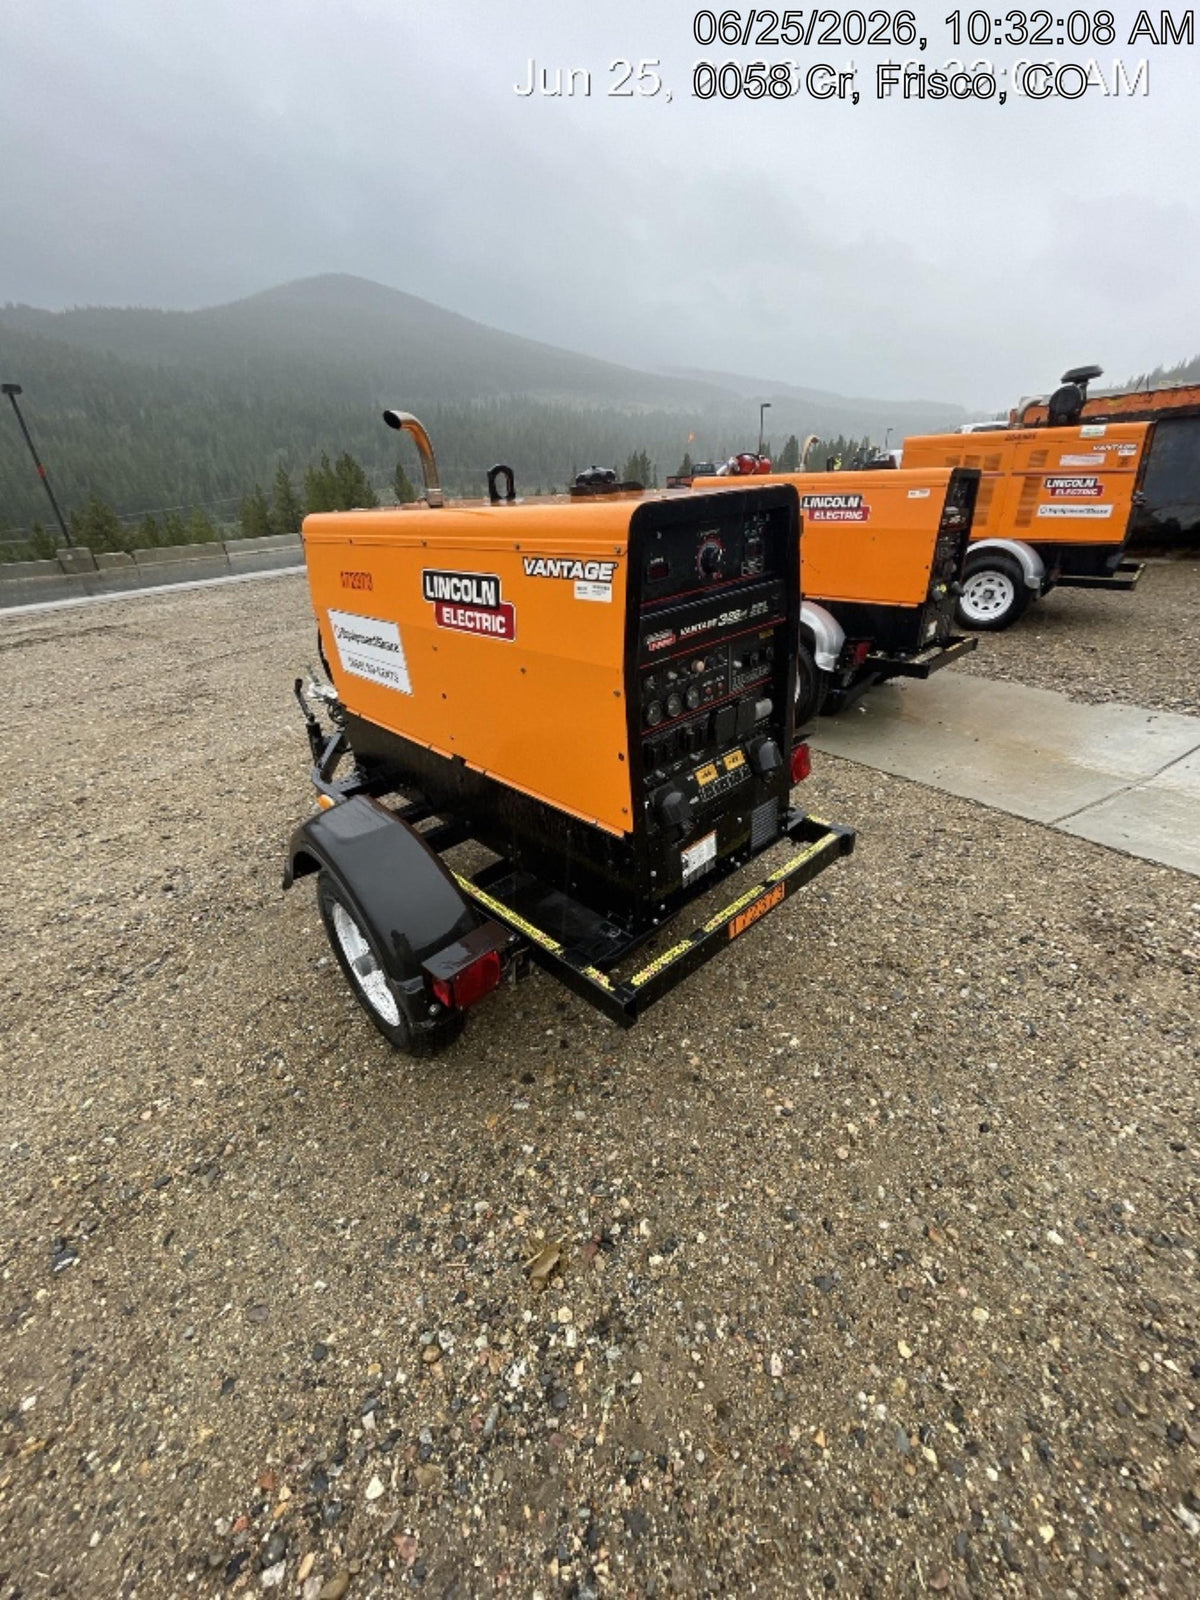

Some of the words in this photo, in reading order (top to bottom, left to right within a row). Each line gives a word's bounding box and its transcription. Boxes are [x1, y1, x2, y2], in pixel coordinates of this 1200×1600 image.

[1046, 479, 1096, 488] LINCOLN
[803, 496, 860, 508] LINCOLN
[813, 510, 863, 520] ELECTRIC
[522, 557, 616, 582] VANTAGE
[425, 575, 497, 607] LINCOLN
[442, 606, 506, 634] ELECTRIC
